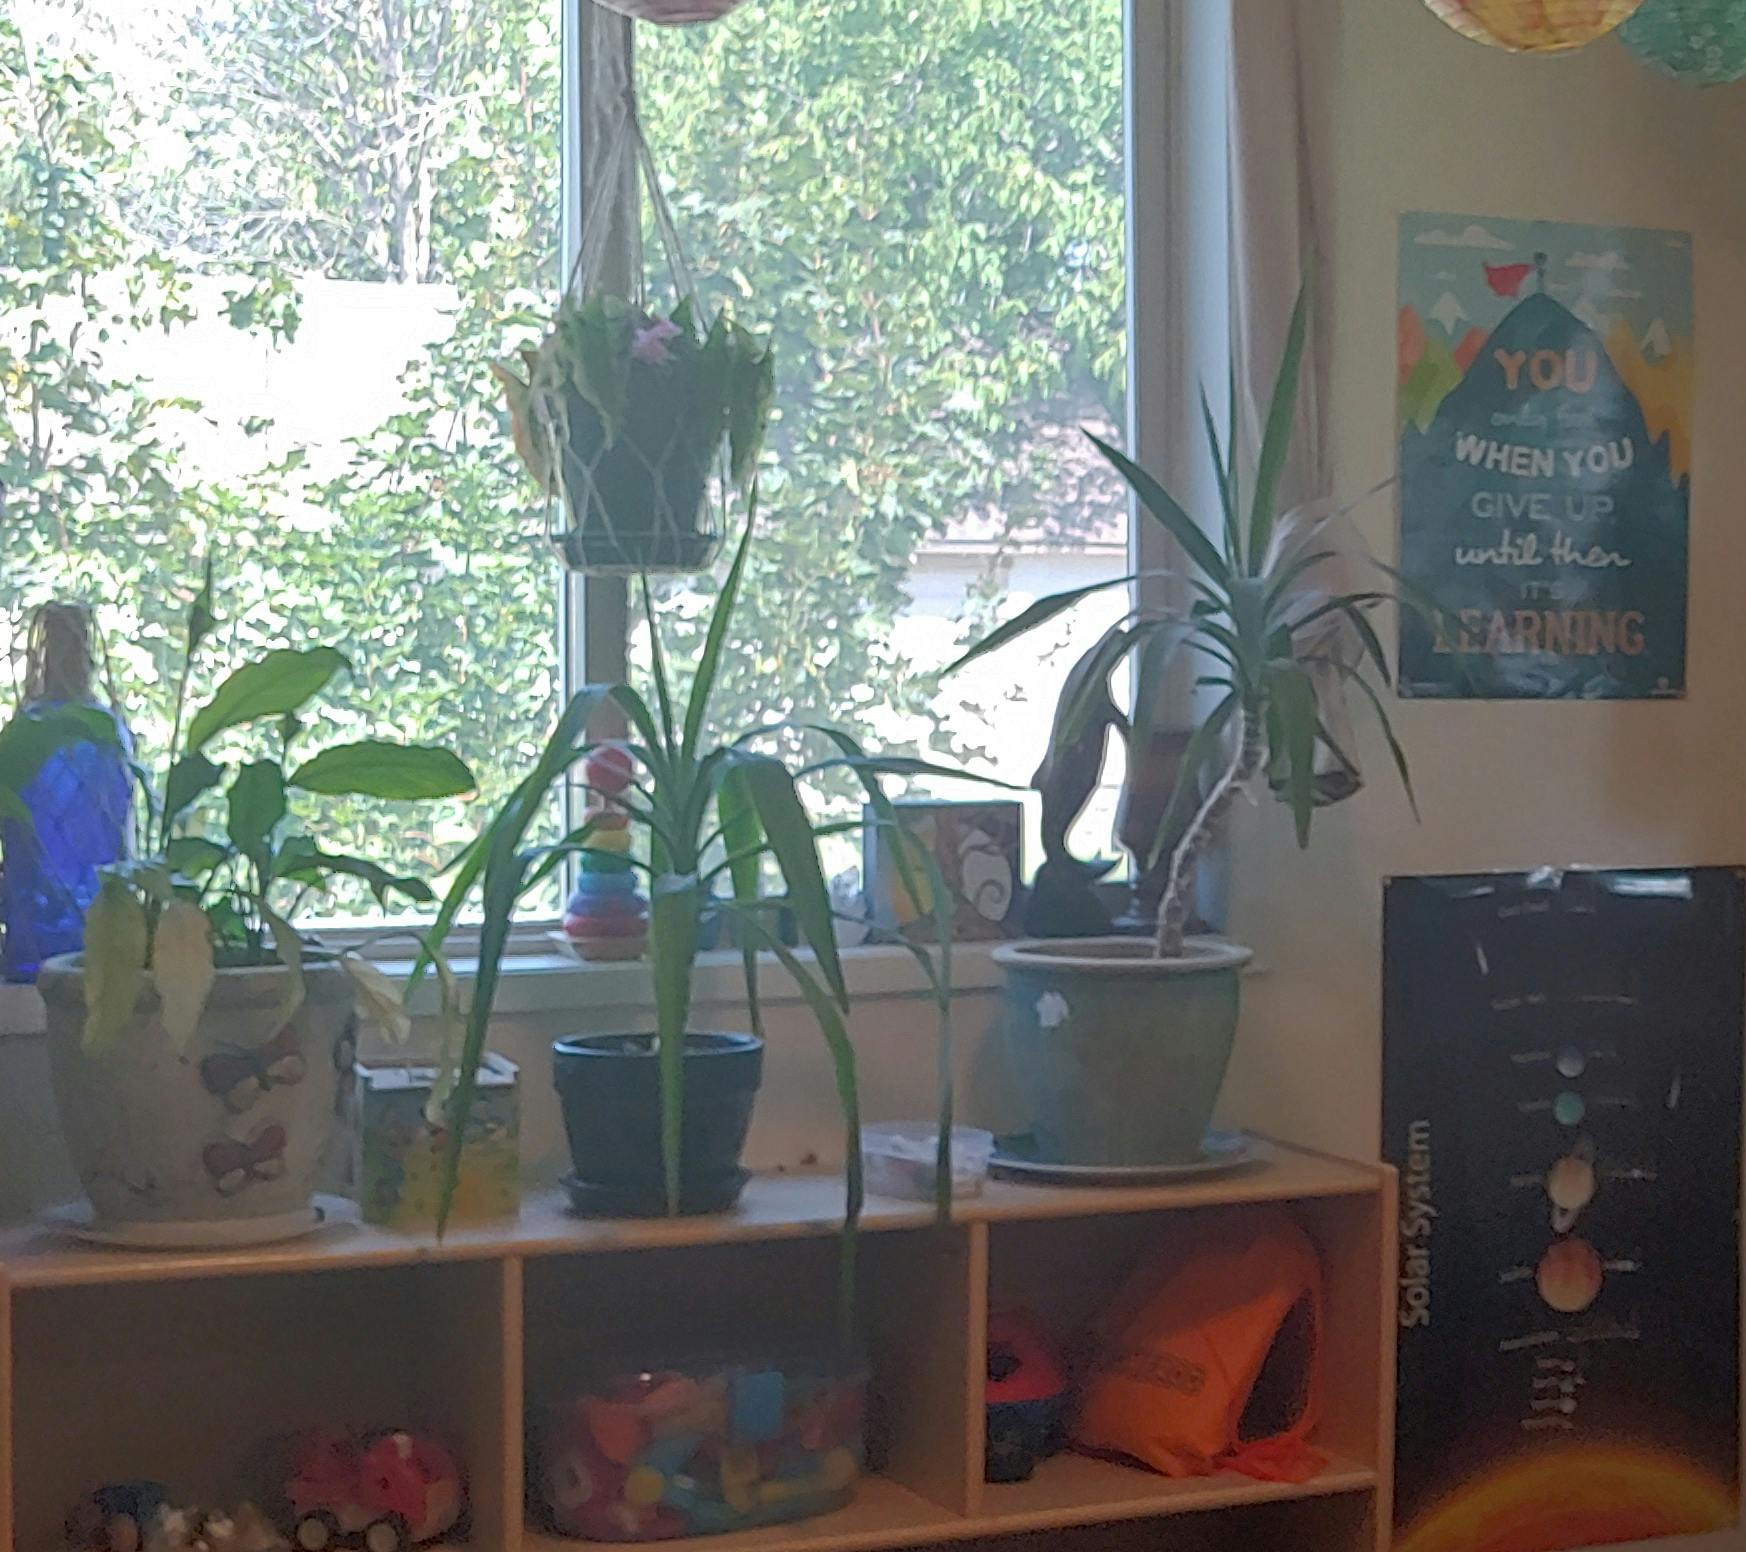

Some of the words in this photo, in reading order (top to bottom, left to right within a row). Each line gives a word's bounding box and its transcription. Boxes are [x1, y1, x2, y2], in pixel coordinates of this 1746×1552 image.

[1495, 348, 1597, 393] YOU
[1455, 431, 1555, 478] WHEN
[1562, 437, 1634, 478] YOU
[1471, 491, 1553, 521] GIVE
[1454, 529, 1543, 567] until
[1549, 529, 1632, 567] then
[1432, 608, 1646, 656] LEARNING
[1400, 1119, 1439, 1238] System
[1399, 1243, 1432, 1328] Solar
